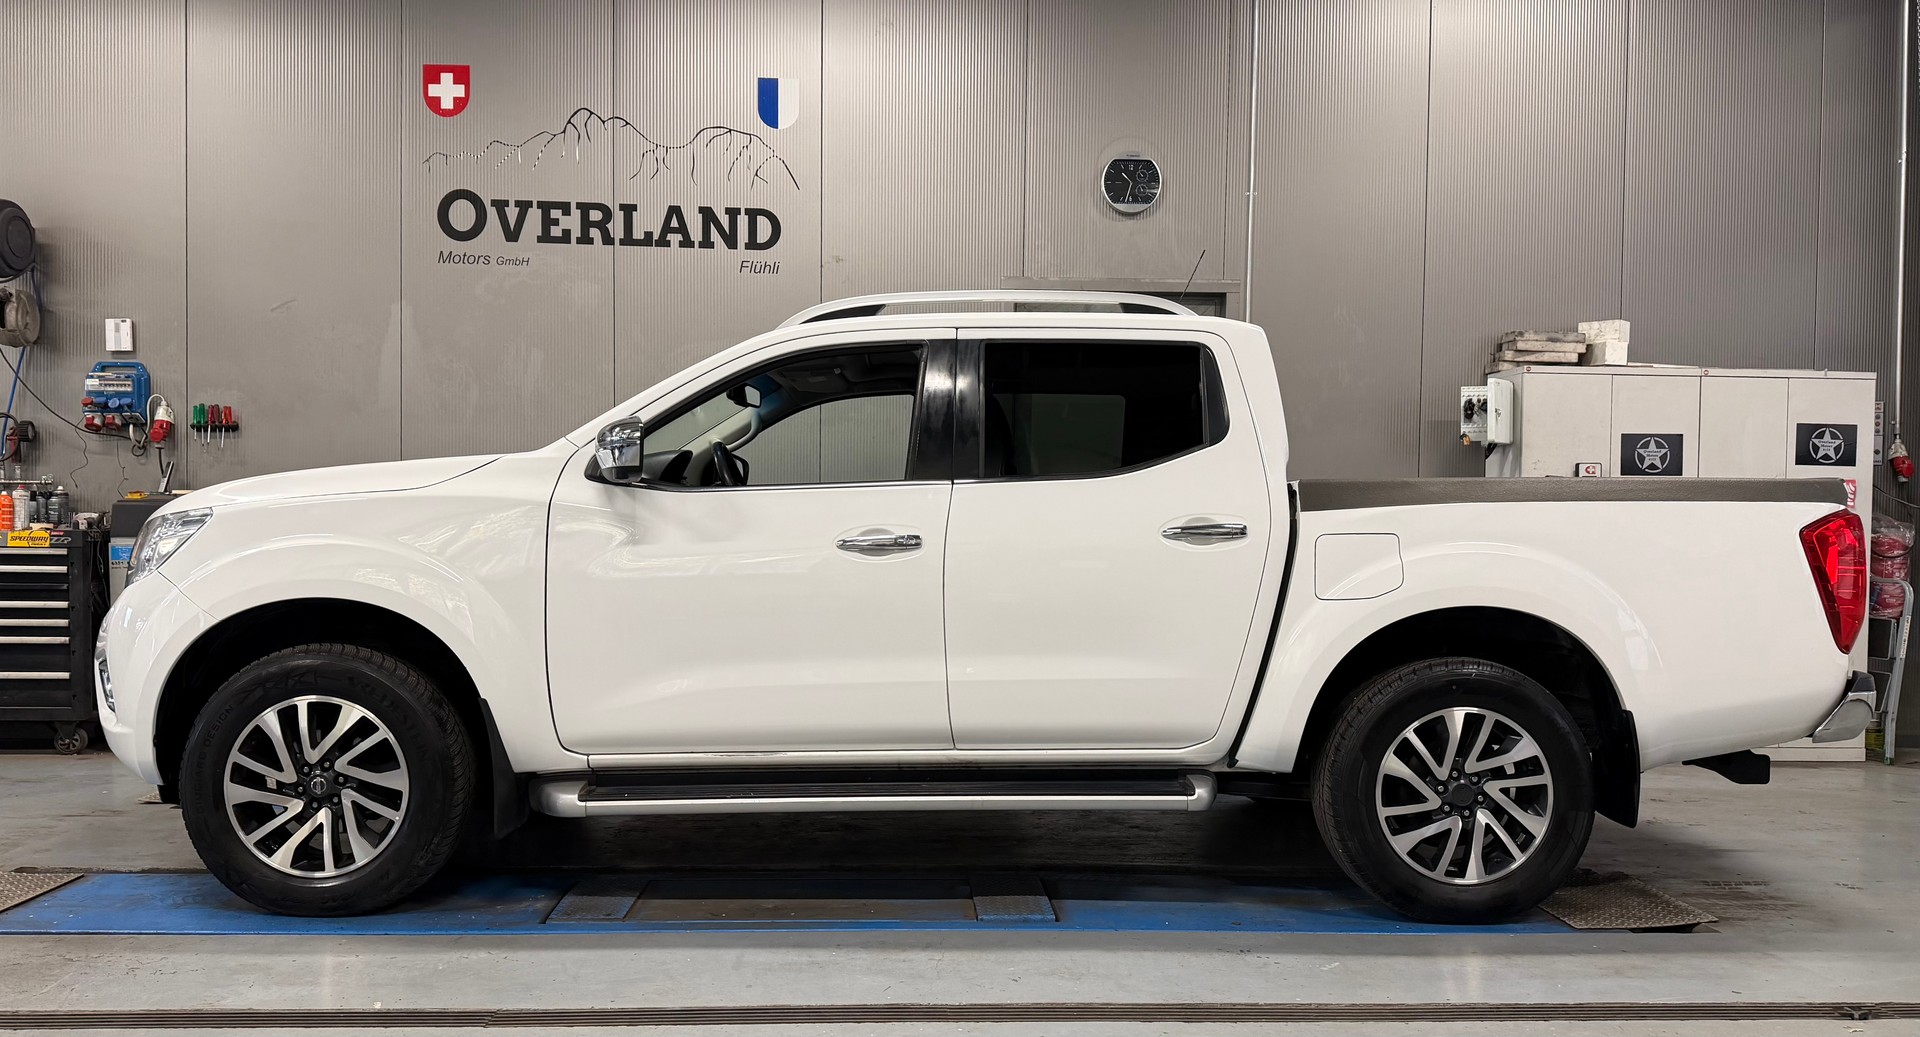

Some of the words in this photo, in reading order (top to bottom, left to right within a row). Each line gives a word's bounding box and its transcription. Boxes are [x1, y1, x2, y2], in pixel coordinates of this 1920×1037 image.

[437, 250, 491, 266] Motors
[495, 255, 530, 267] GmbH
[739, 259, 780, 275] Flühli
[10, 535, 49, 543] SPEEDWAY
[204, 702, 236, 748] DESIGN
